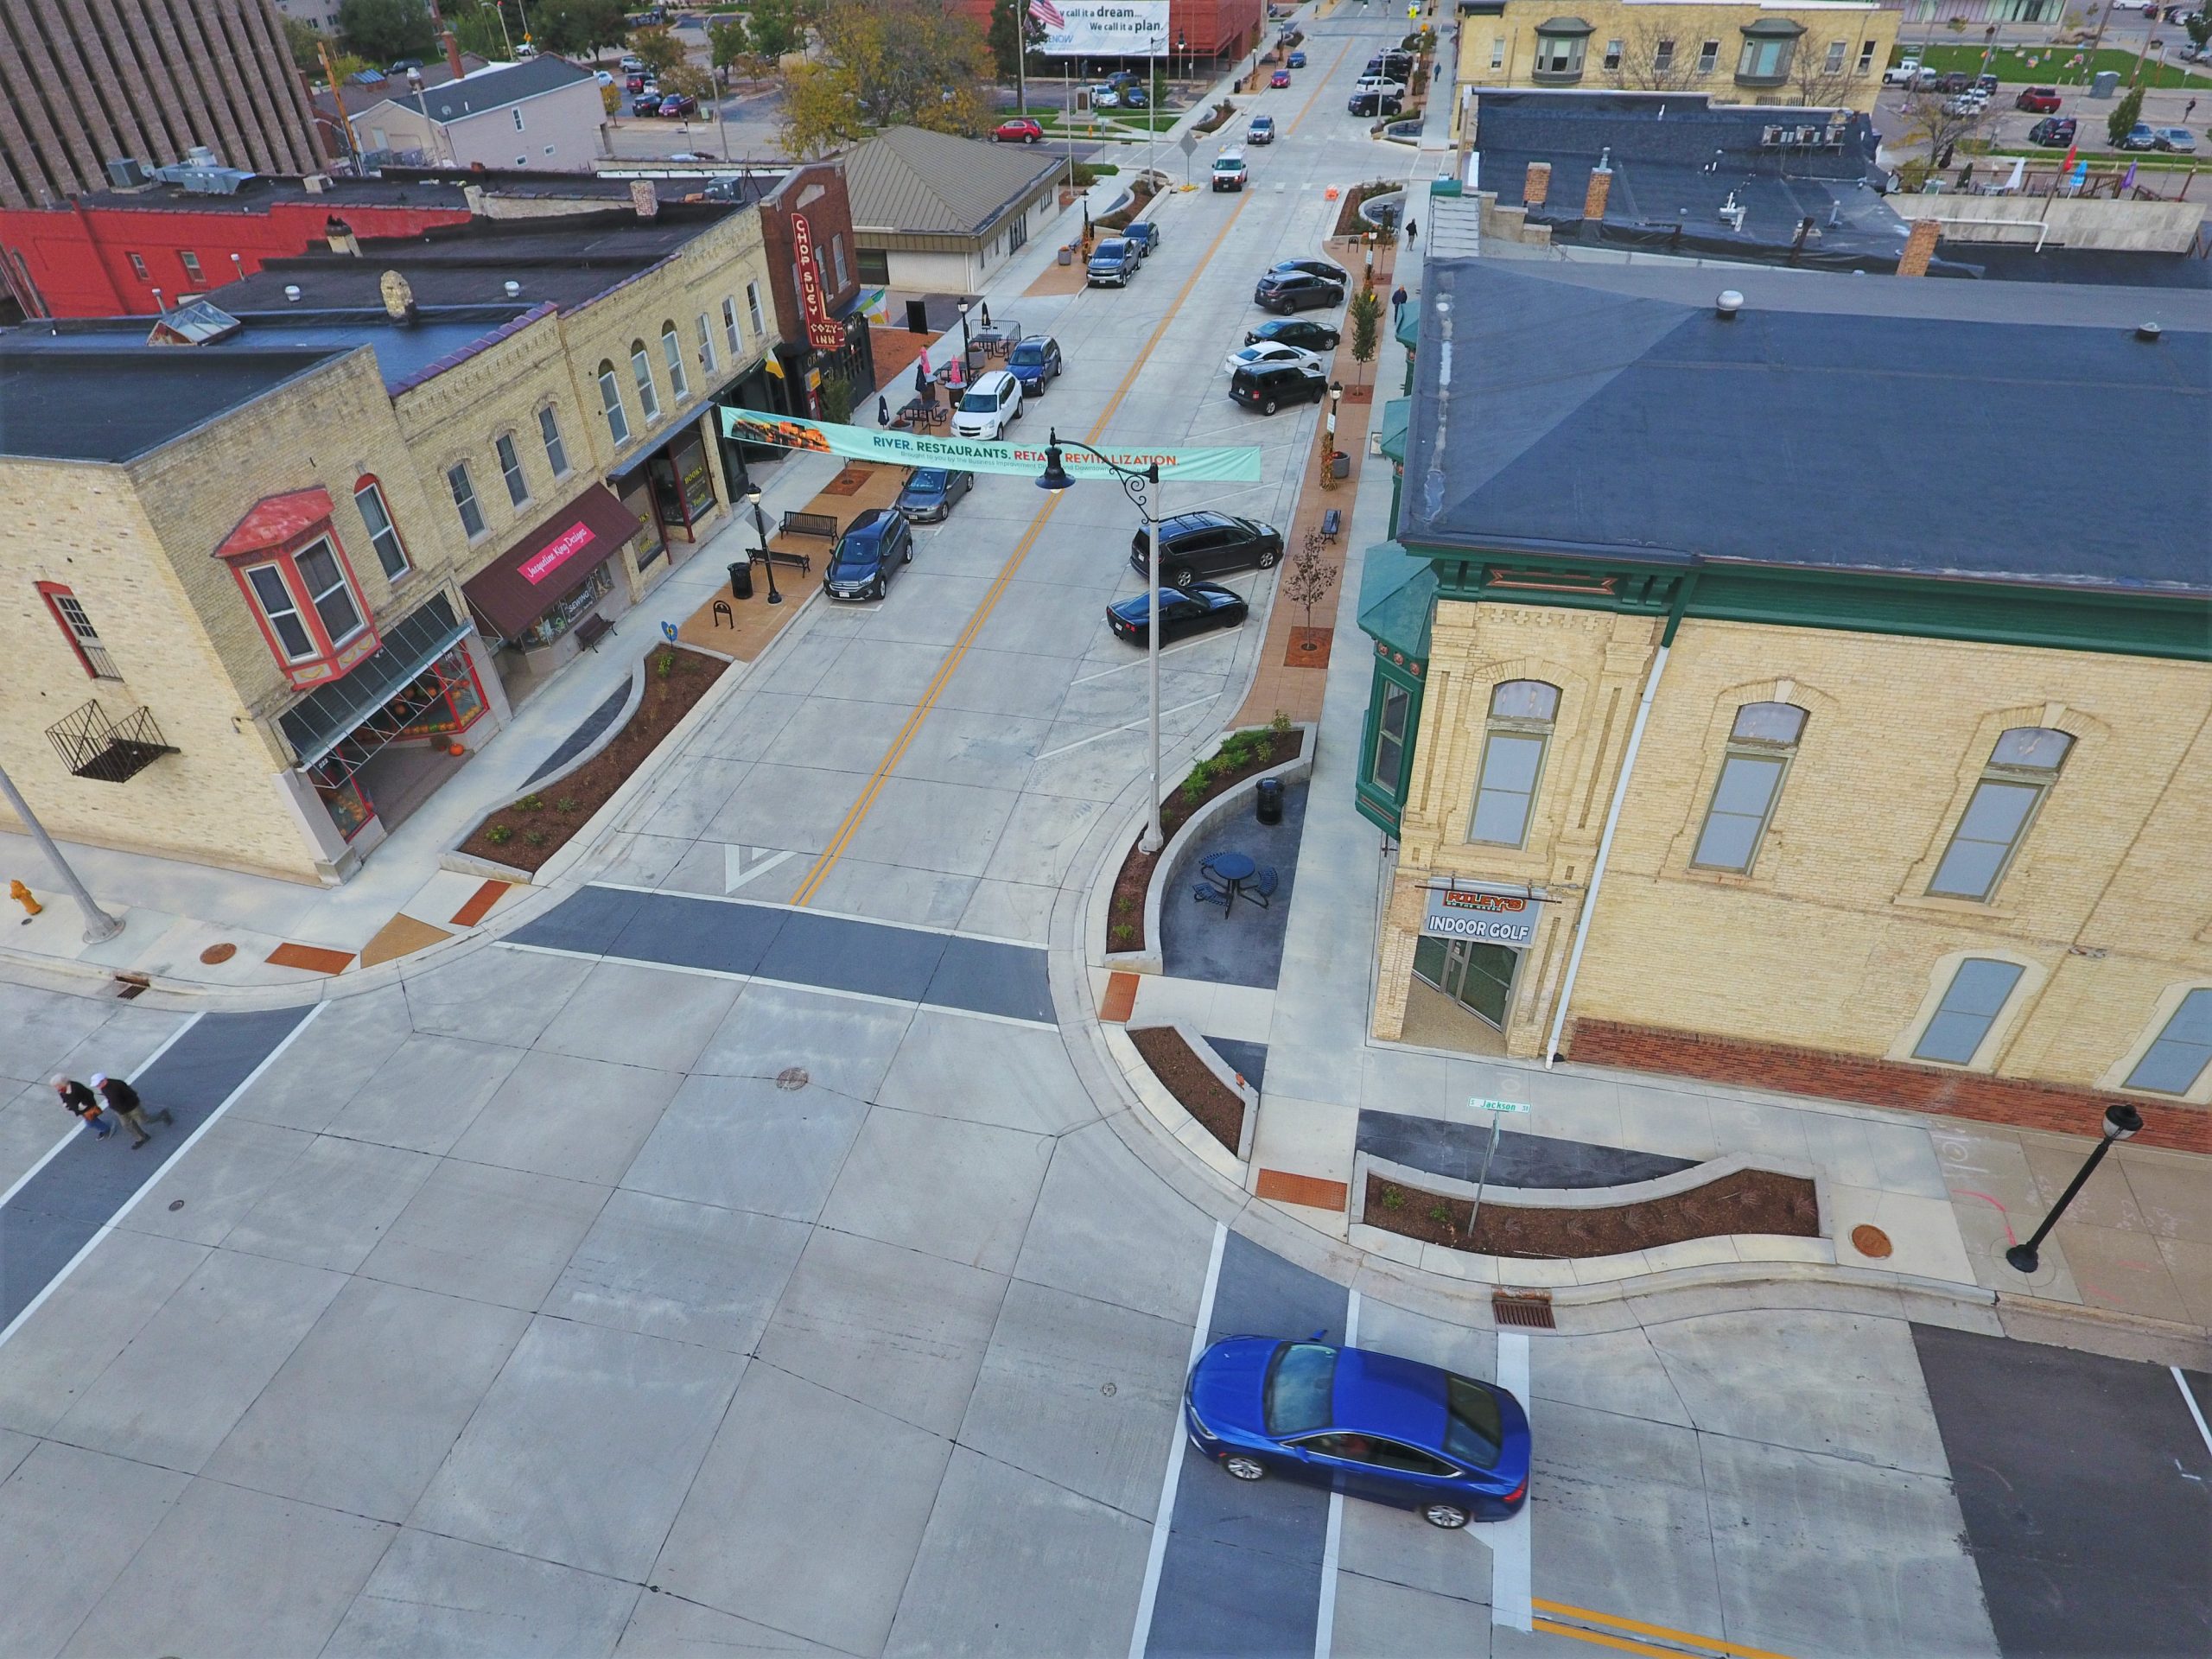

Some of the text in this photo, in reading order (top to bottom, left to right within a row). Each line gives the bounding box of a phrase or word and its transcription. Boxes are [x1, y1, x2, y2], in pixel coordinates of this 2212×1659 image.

[1066, 8, 1080, 17] call
[1082, 8, 1089, 17] it
[1090, 22, 1102, 31] We
[1103, 22, 1118, 31] call
[1120, 22, 1127, 31] it
[1135, 19, 1164, 34] plan.
[796, 220, 817, 315] CHOP SUEY
[810, 323, 837, 334] COZY
[816, 334, 836, 345] INN
[874, 436, 913, 451] RIVER.
[917, 442, 1011, 460] RESTAURANTS.
[900, 451, 926, 460] Brought
[996, 461, 1036, 470] Improvement
[684, 466, 702, 485] BOOKS
[528, 529, 587, 577] Jacqueline King Designs
[568, 590, 590, 613] SEWING
[1447, 891, 1524, 910] RILEY'S
[1428, 916, 1529, 941] INDOOR GOLF
[1480, 1100, 1516, 1111] Jackson
